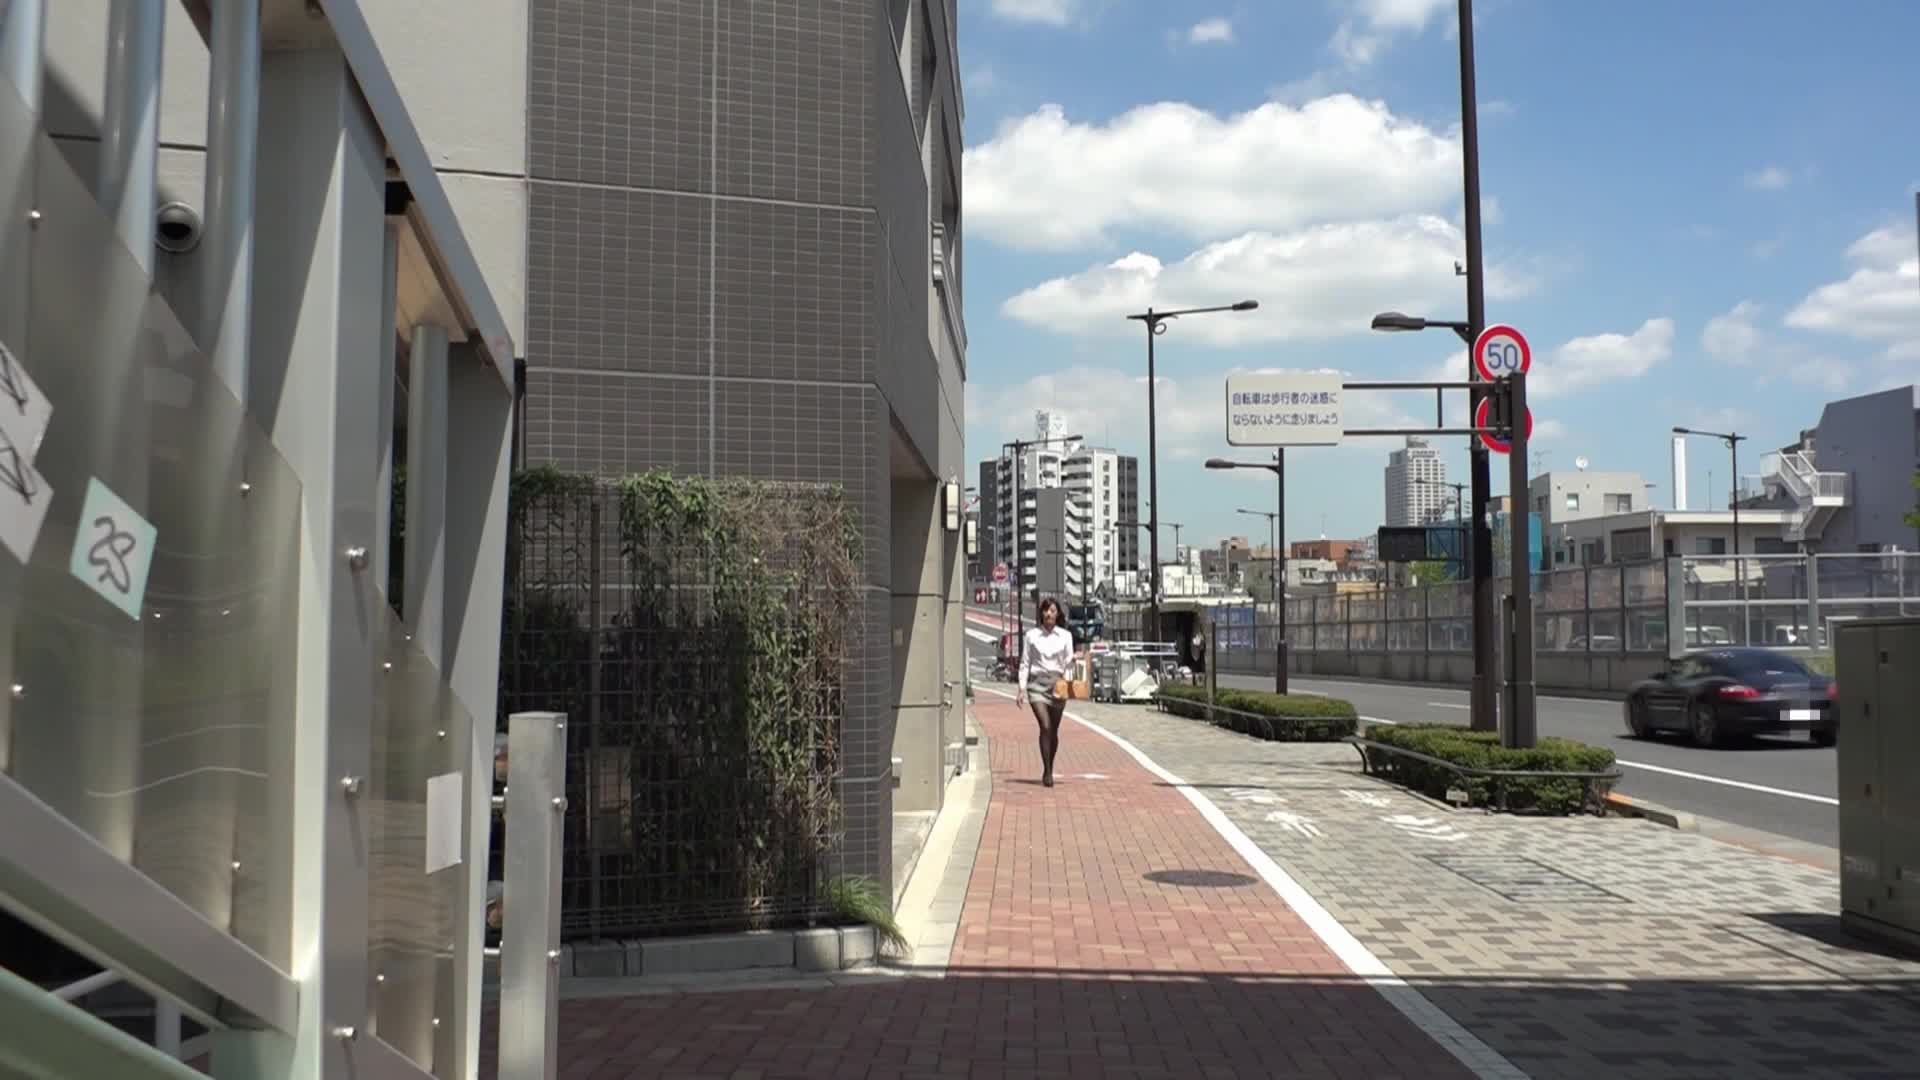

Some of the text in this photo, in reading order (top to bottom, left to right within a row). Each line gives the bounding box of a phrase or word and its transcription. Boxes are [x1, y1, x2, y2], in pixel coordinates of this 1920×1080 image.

[1487, 343, 1519, 370] 50
[1232, 391, 1337, 406] 自転車は歩行者の迷惑に
[1232, 412, 1338, 426] ならないように走りましょう
